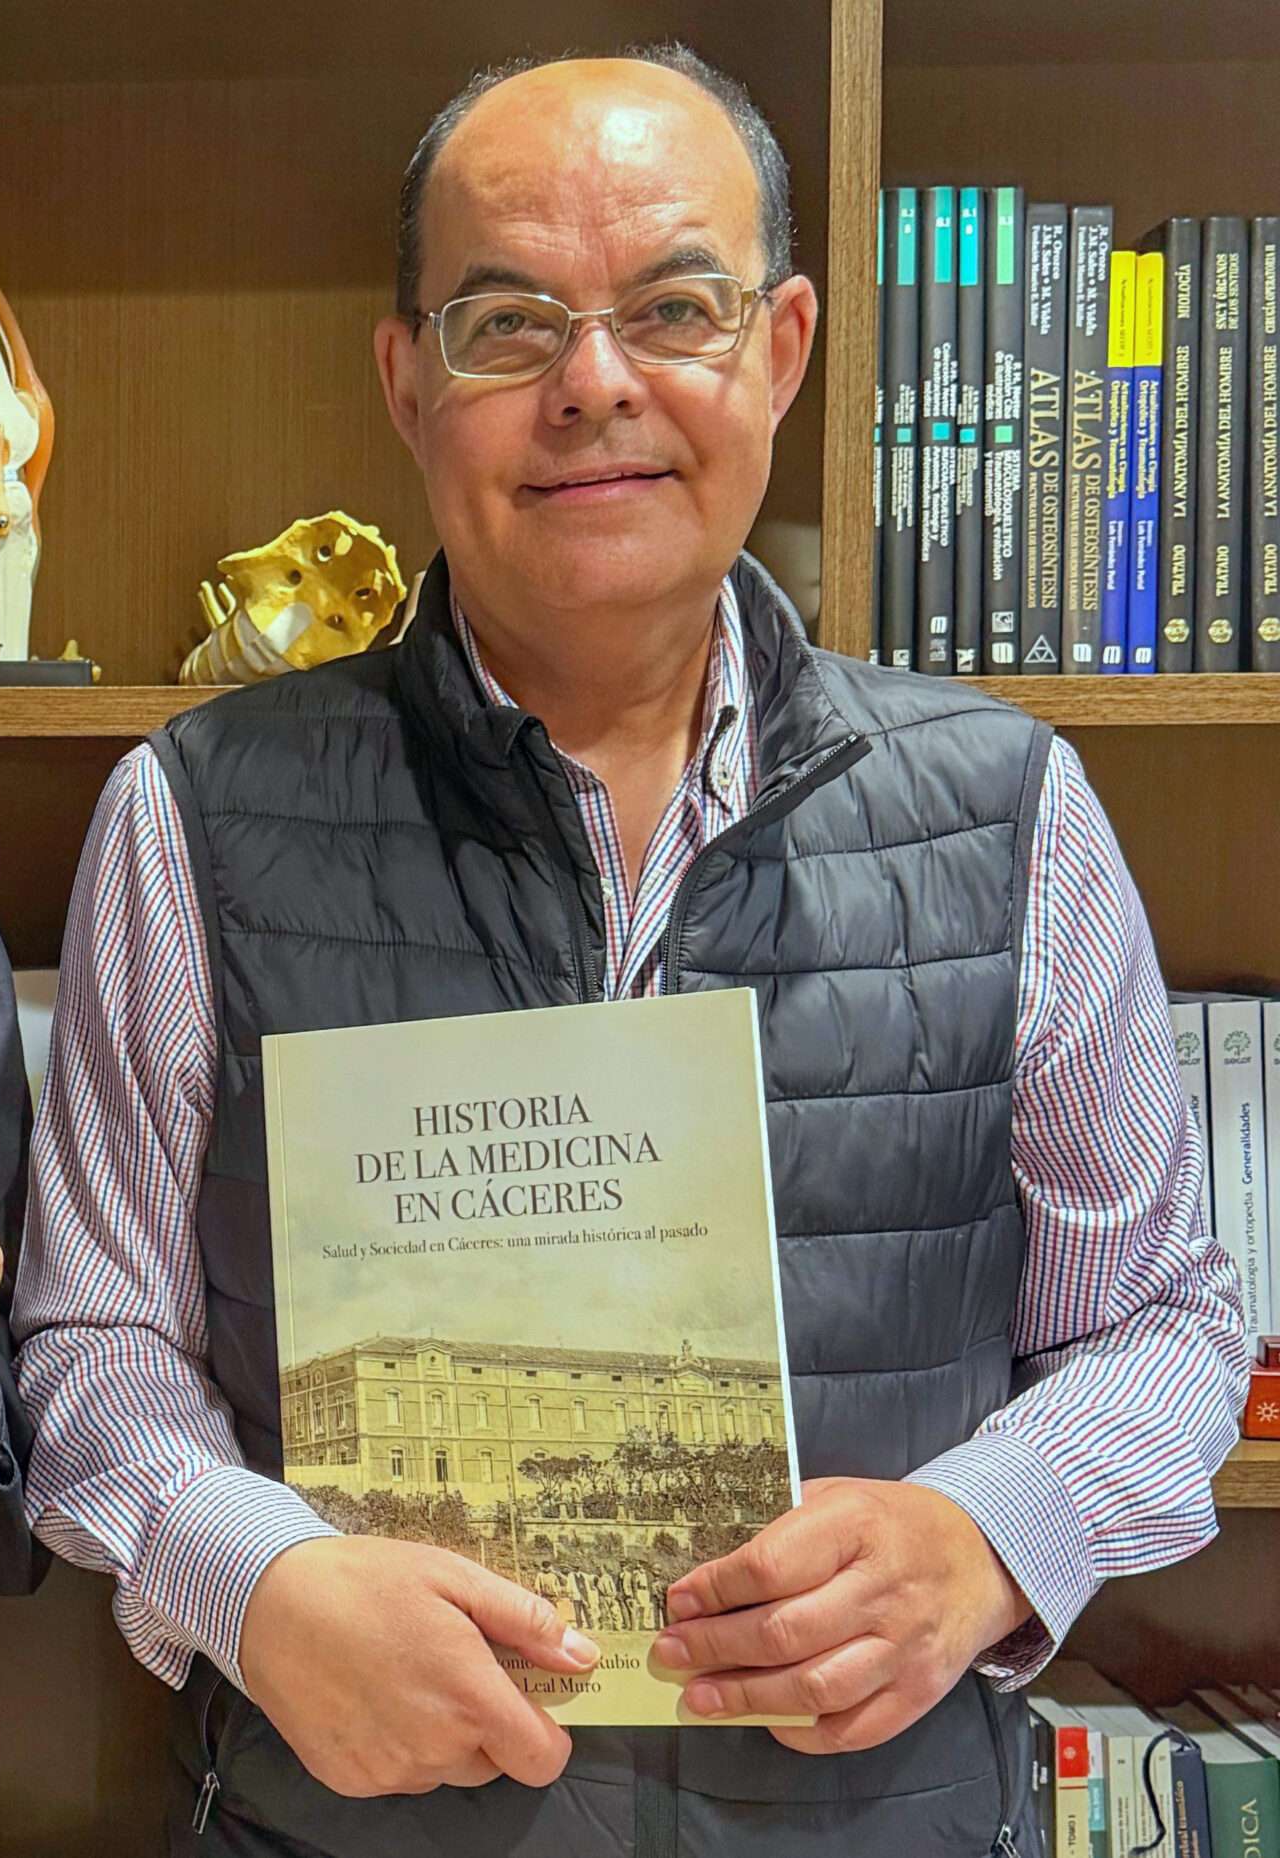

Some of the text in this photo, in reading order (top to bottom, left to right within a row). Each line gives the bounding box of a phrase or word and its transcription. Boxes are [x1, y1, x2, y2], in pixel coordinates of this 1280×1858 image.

[1041, 250, 1052, 277] Sales
[1053, 240, 1062, 280] Orozco
[1087, 251, 1098, 278] Sales
[1098, 242, 1108, 281] Orozco
[1174, 264, 1191, 318] MIOLOGÍA
[1029, 367, 1062, 609] ATLAS DE OSTEOSÍNTESIS
[1072, 370, 1105, 611] ATLAS DE OSTEOSÍNTESIS
[1172, 345, 1190, 596] TRATADO LA ANATOMÍA DEL HOMBRE
[1215, 347, 1233, 597] TRATADO LA ANATOMÍA DEL HOMBRE
[1261, 345, 1278, 595] TRATADO LA ANATOMÍA DEL HOMBRE
[414, 1093, 592, 1136] HISTORIA
[355, 1132, 662, 1183] DE LA MEDICINA
[1240, 1102, 1254, 1184] Generalidades
[395, 1179, 623, 1224] EN CÁCERES
[1243, 1192, 1255, 1245] ortopedia
[322, 1223, 708, 1261] Salud y Sociedad en Cáceres: una mirada histórica al pasado
[523, 1677, 601, 1694] Leal Muro
